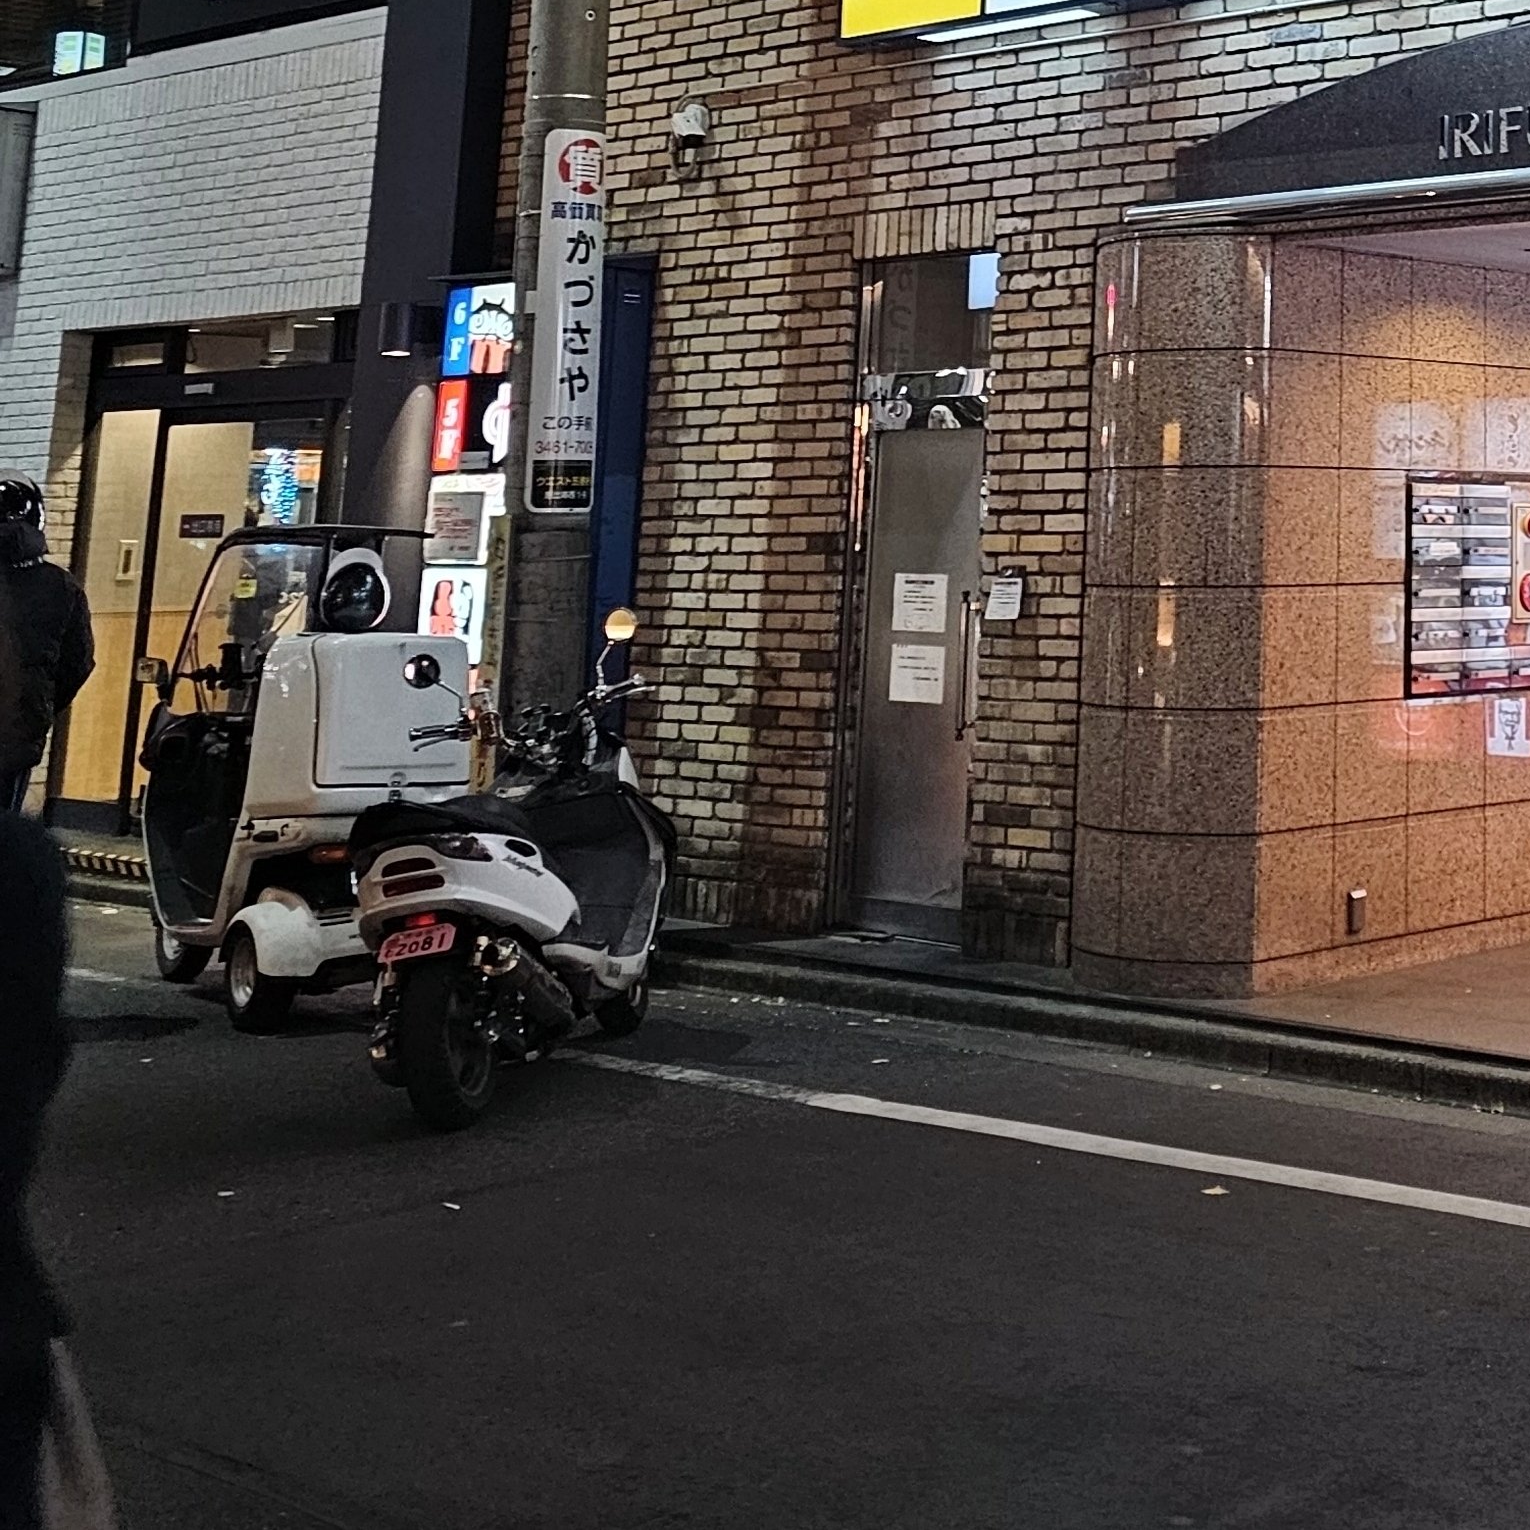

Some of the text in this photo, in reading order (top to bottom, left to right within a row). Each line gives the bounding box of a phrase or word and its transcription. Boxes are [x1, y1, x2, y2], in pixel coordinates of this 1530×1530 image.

[448, 300, 468, 362] 6F
[439, 397, 461, 461] 5F
[396, 931, 446, 956] 2081
